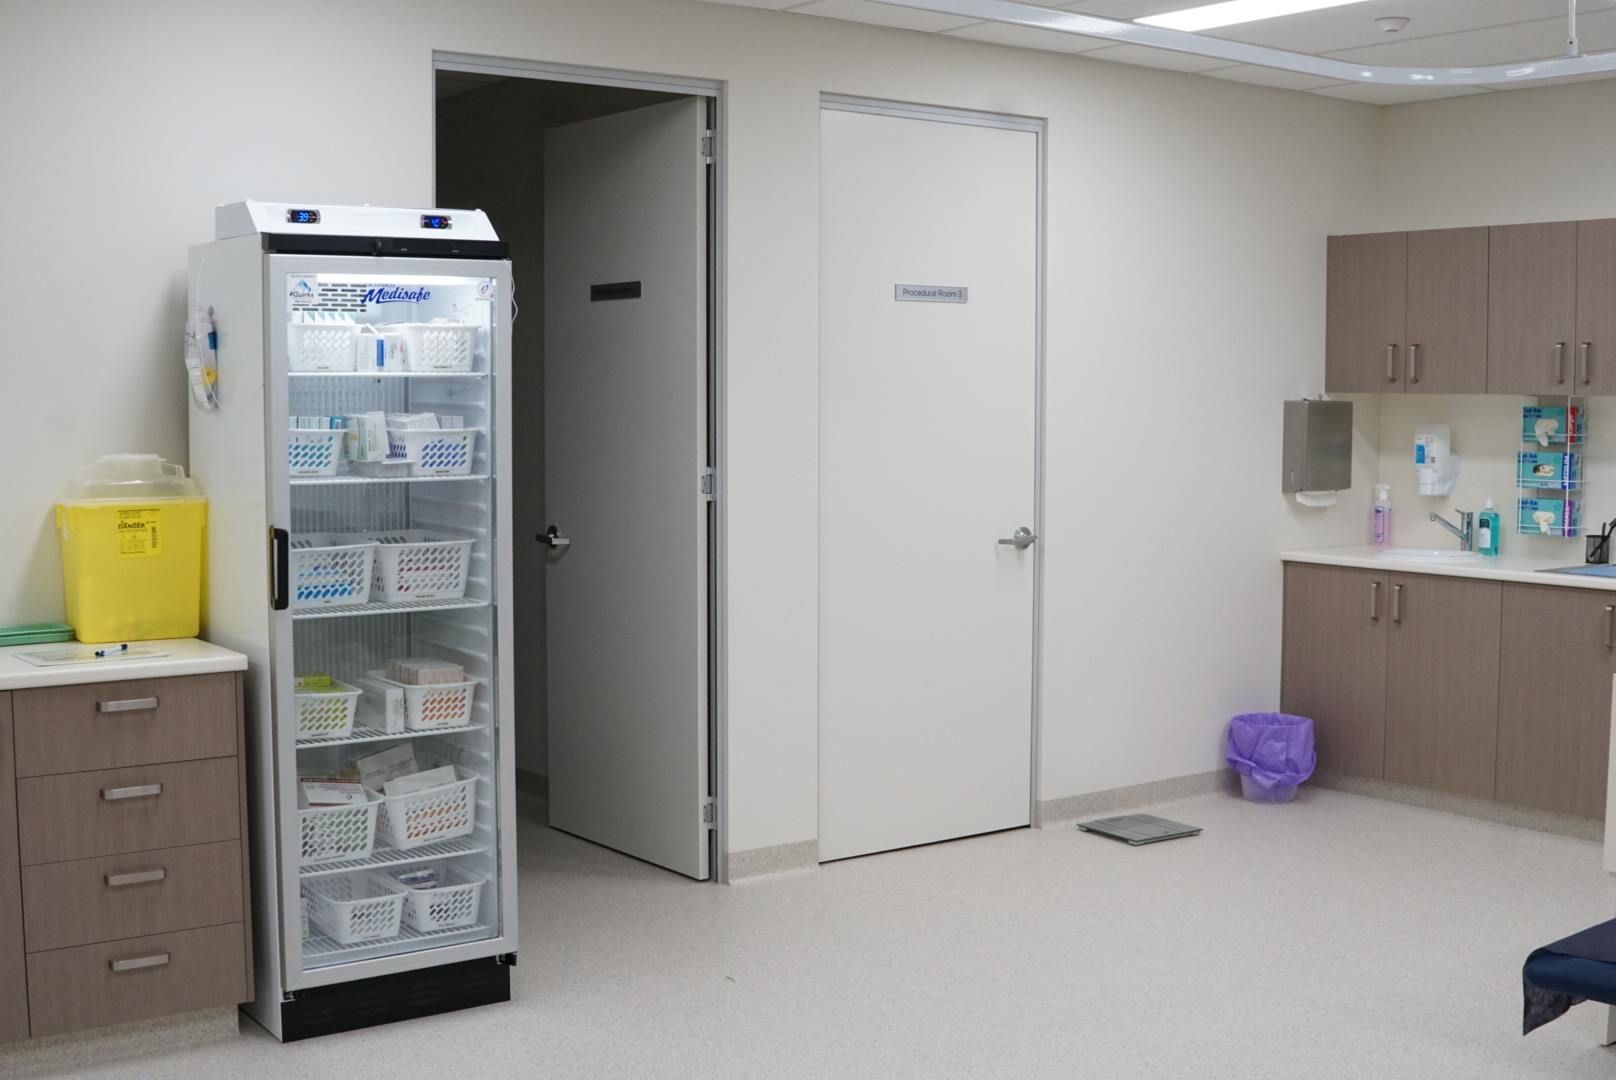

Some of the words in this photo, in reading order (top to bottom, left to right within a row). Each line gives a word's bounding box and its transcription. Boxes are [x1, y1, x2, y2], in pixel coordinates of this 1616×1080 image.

[360, 287, 431, 304] Medisafe
[902, 288, 937, 296] Procedural
[938, 289, 957, 298] Room
[118, 522, 145, 530] DANGER
